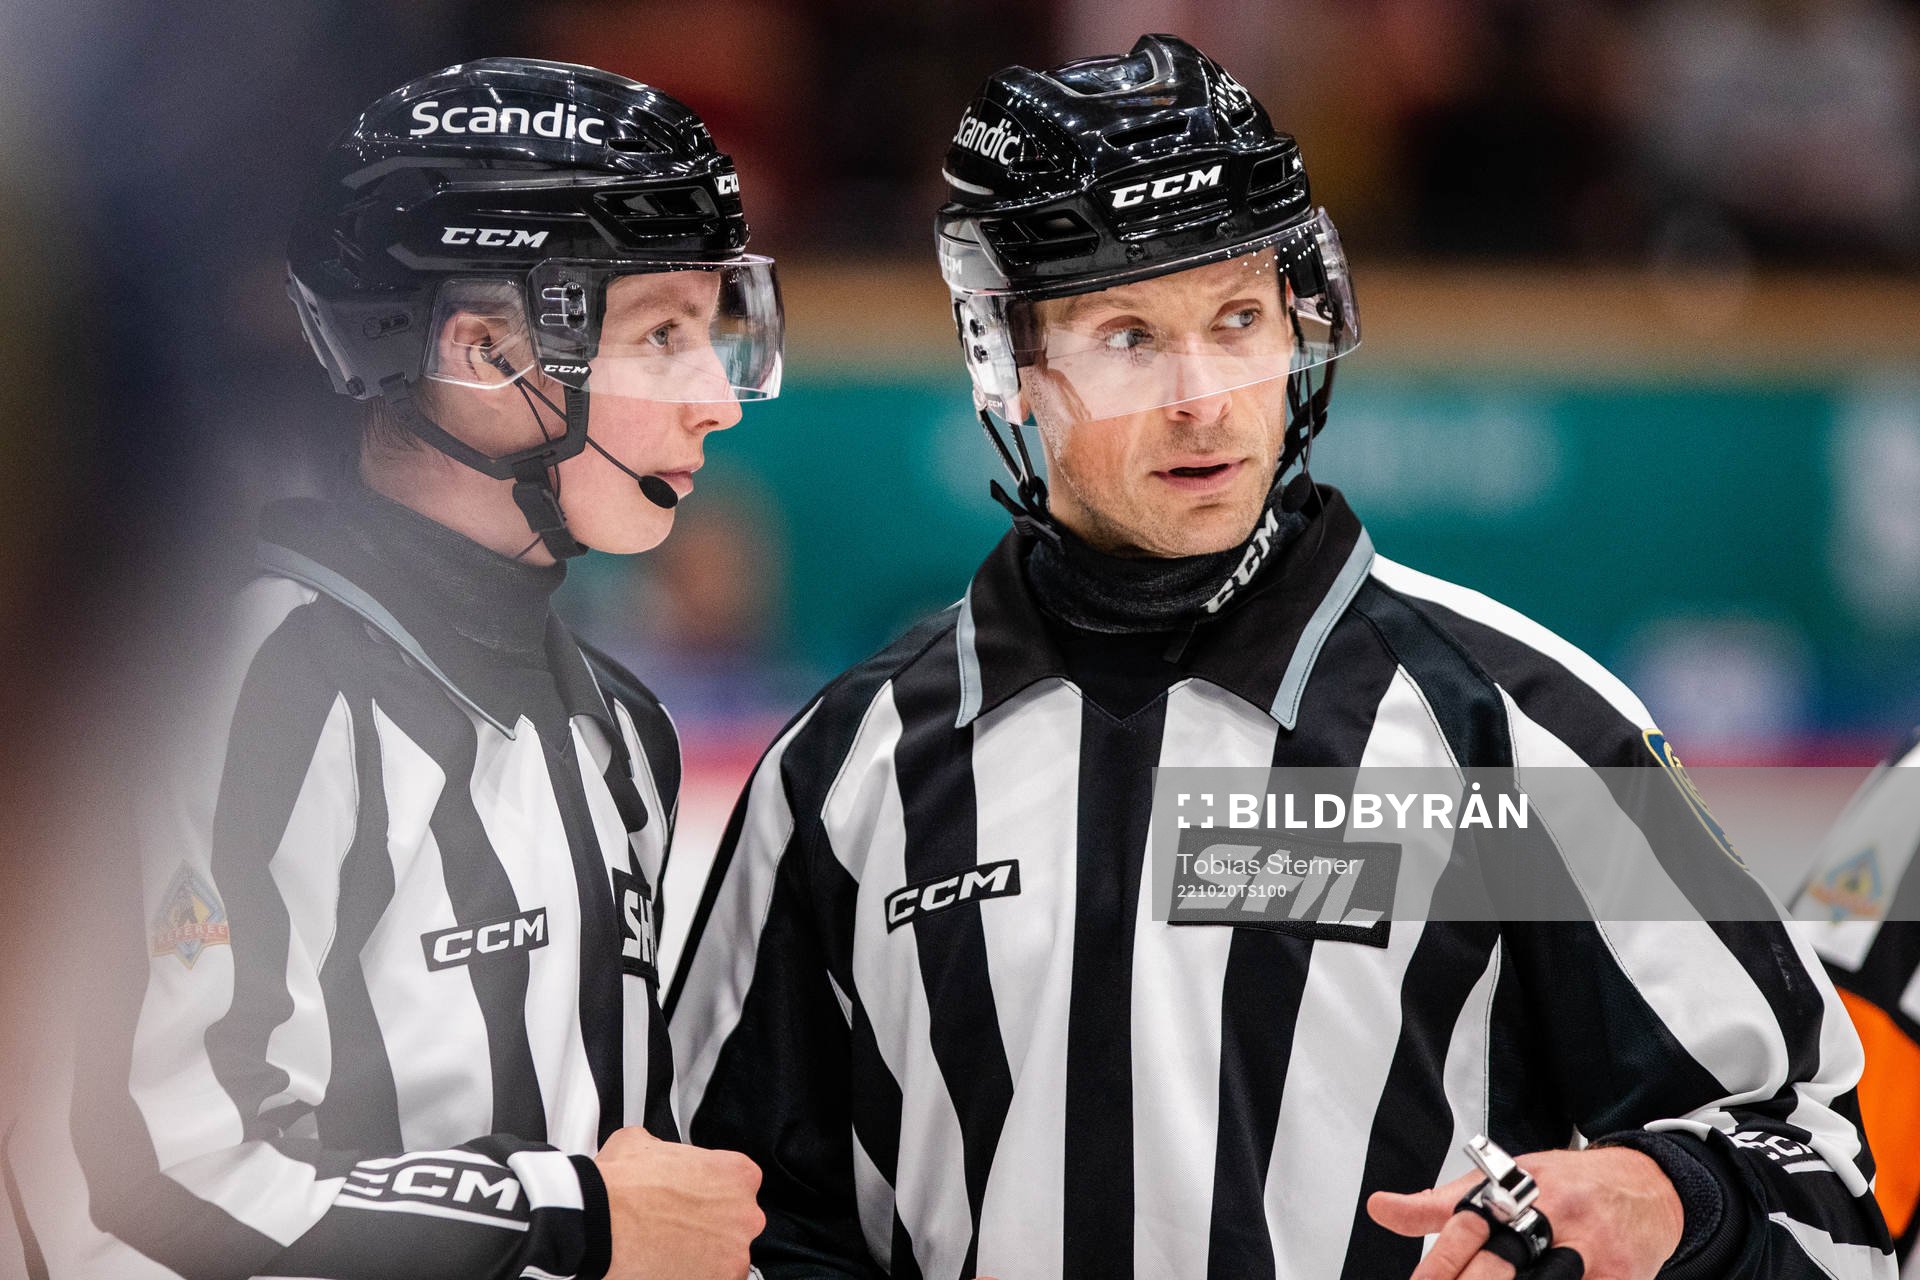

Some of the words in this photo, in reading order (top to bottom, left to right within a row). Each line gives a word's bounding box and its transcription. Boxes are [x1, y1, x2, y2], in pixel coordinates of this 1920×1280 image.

[410, 101, 605, 145] Scandic
[716, 173, 740, 195] CC
[1110, 165, 1222, 208] CCM
[441, 227, 549, 248] CCM
[543, 364, 588, 374] CCM
[1200, 507, 1279, 613] CCM
[888, 865, 1012, 924] CCM
[433, 913, 544, 962] CCM
[622, 888, 658, 968] SH
